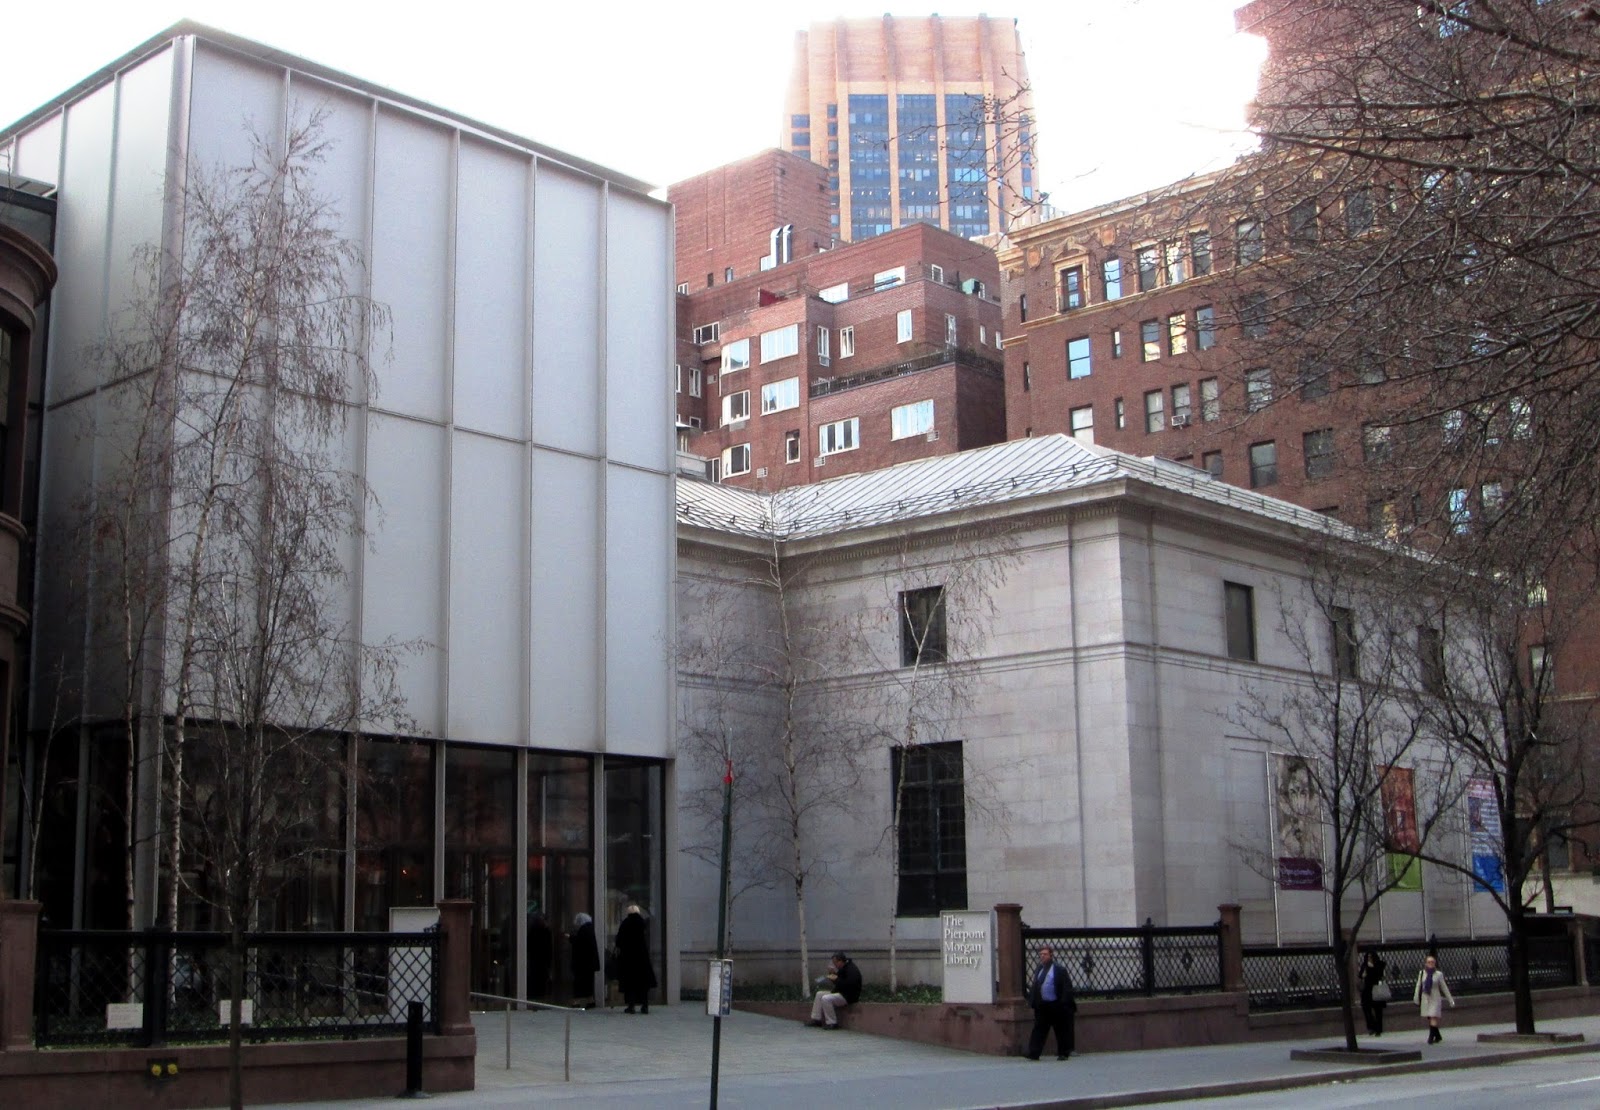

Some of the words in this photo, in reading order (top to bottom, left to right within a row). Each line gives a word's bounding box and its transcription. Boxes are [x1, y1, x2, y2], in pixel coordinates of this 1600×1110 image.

[943, 914, 963, 926] The
[944, 928, 985, 942] Pierpont
[944, 941, 982, 955] Morgan
[944, 952, 980, 969] Library
